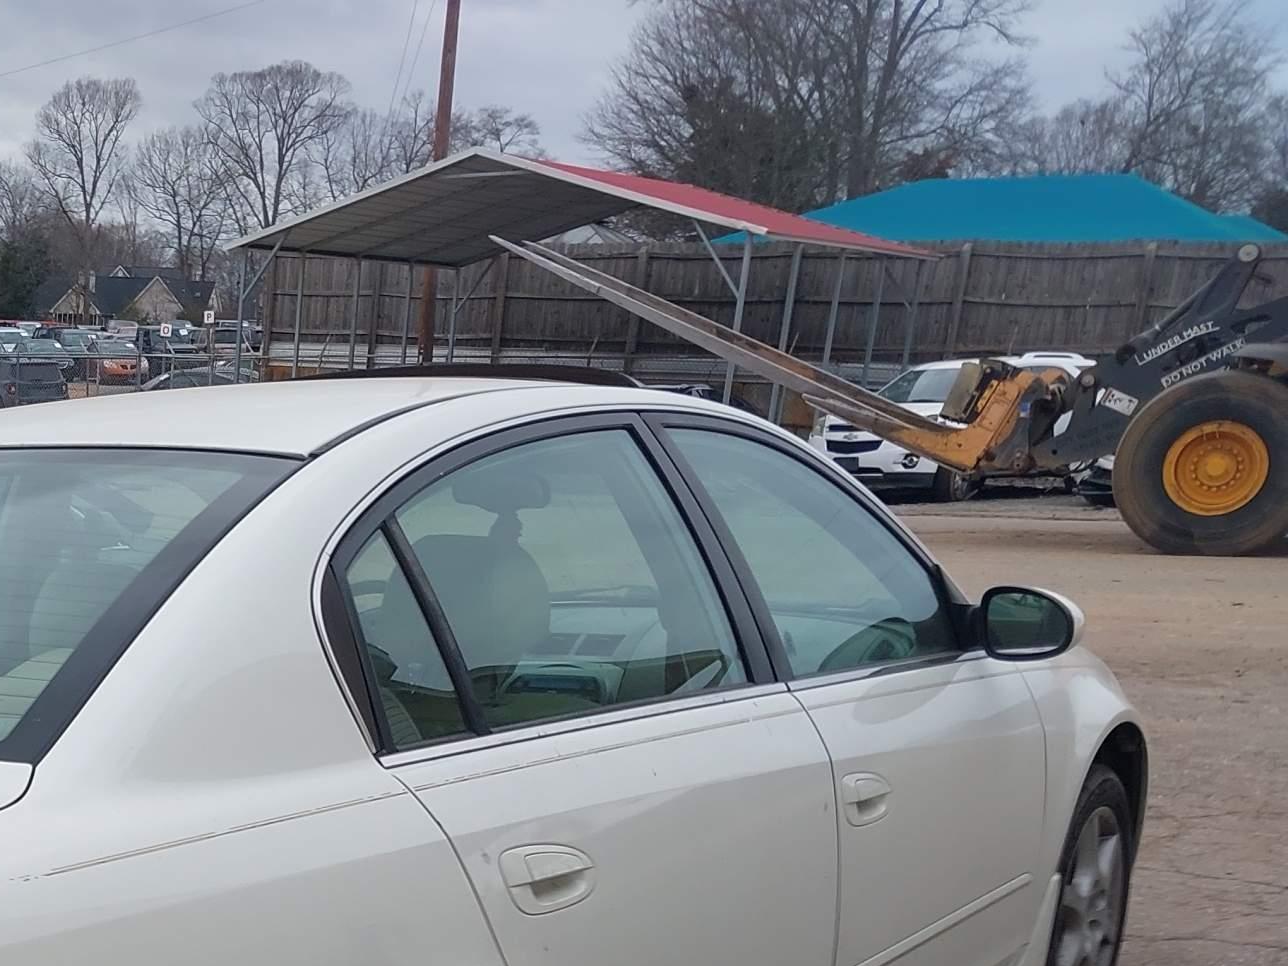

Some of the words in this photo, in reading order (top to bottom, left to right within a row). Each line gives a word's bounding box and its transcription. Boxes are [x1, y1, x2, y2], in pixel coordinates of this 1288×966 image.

[1143, 335, 1181, 359] UNDER
[1182, 321, 1214, 338] MAST
[1163, 373, 1181, 388] DO
[1181, 359, 1208, 379] NOT
[1208, 338, 1246, 363] WALK
